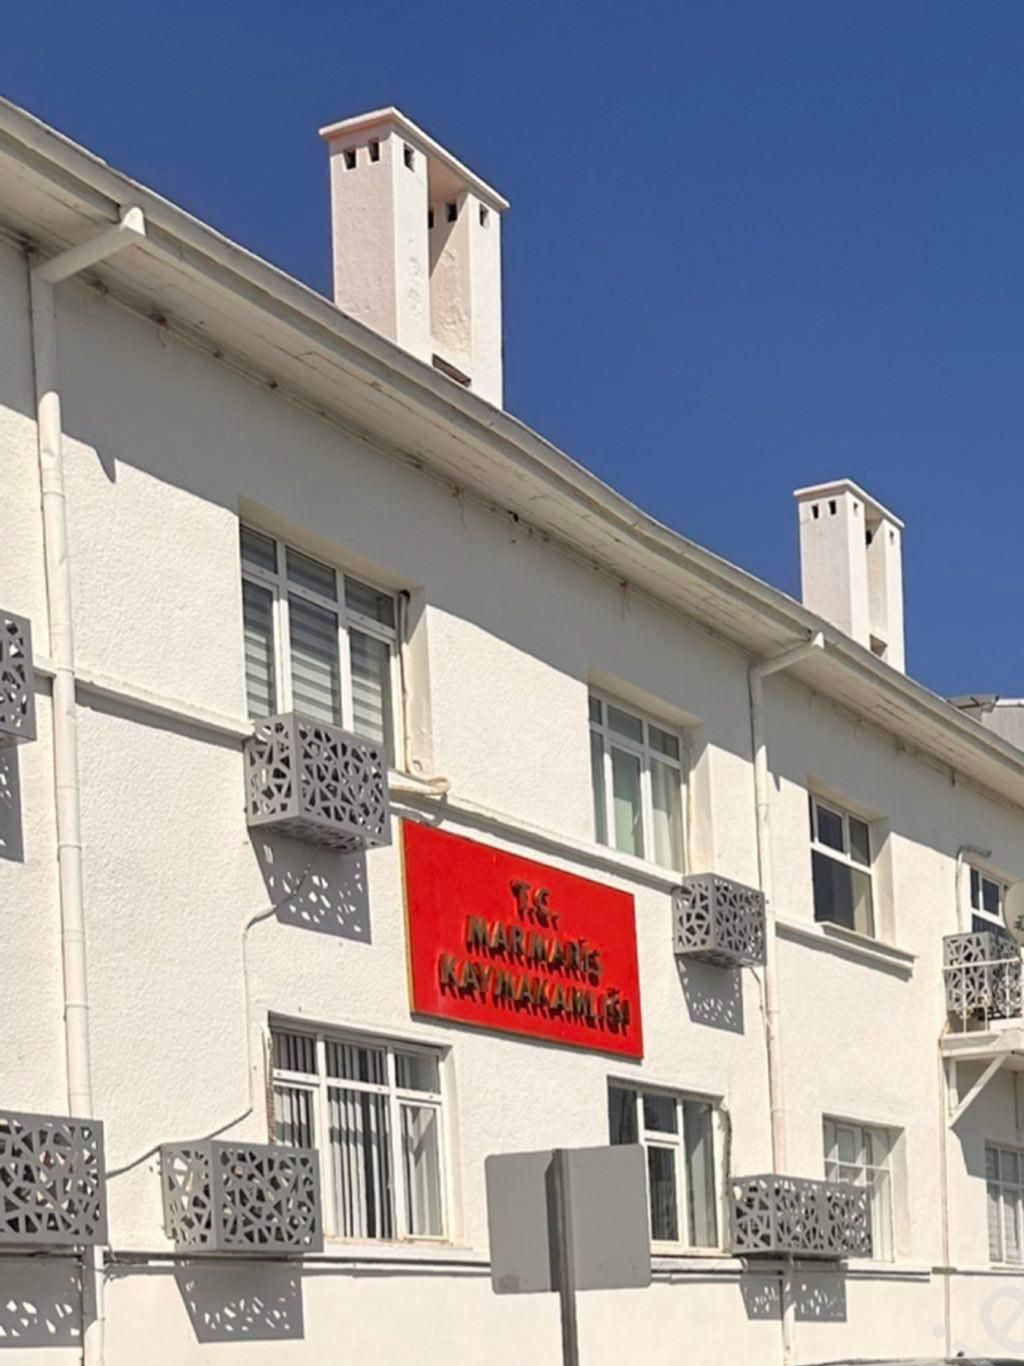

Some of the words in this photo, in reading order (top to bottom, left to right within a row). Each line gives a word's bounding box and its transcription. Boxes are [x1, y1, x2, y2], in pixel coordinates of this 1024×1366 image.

[509, 880, 559, 930] T.C.
[463, 914, 603, 986] MARMARİS
[437, 953, 630, 1036] KAYMAKAMLIĞI
